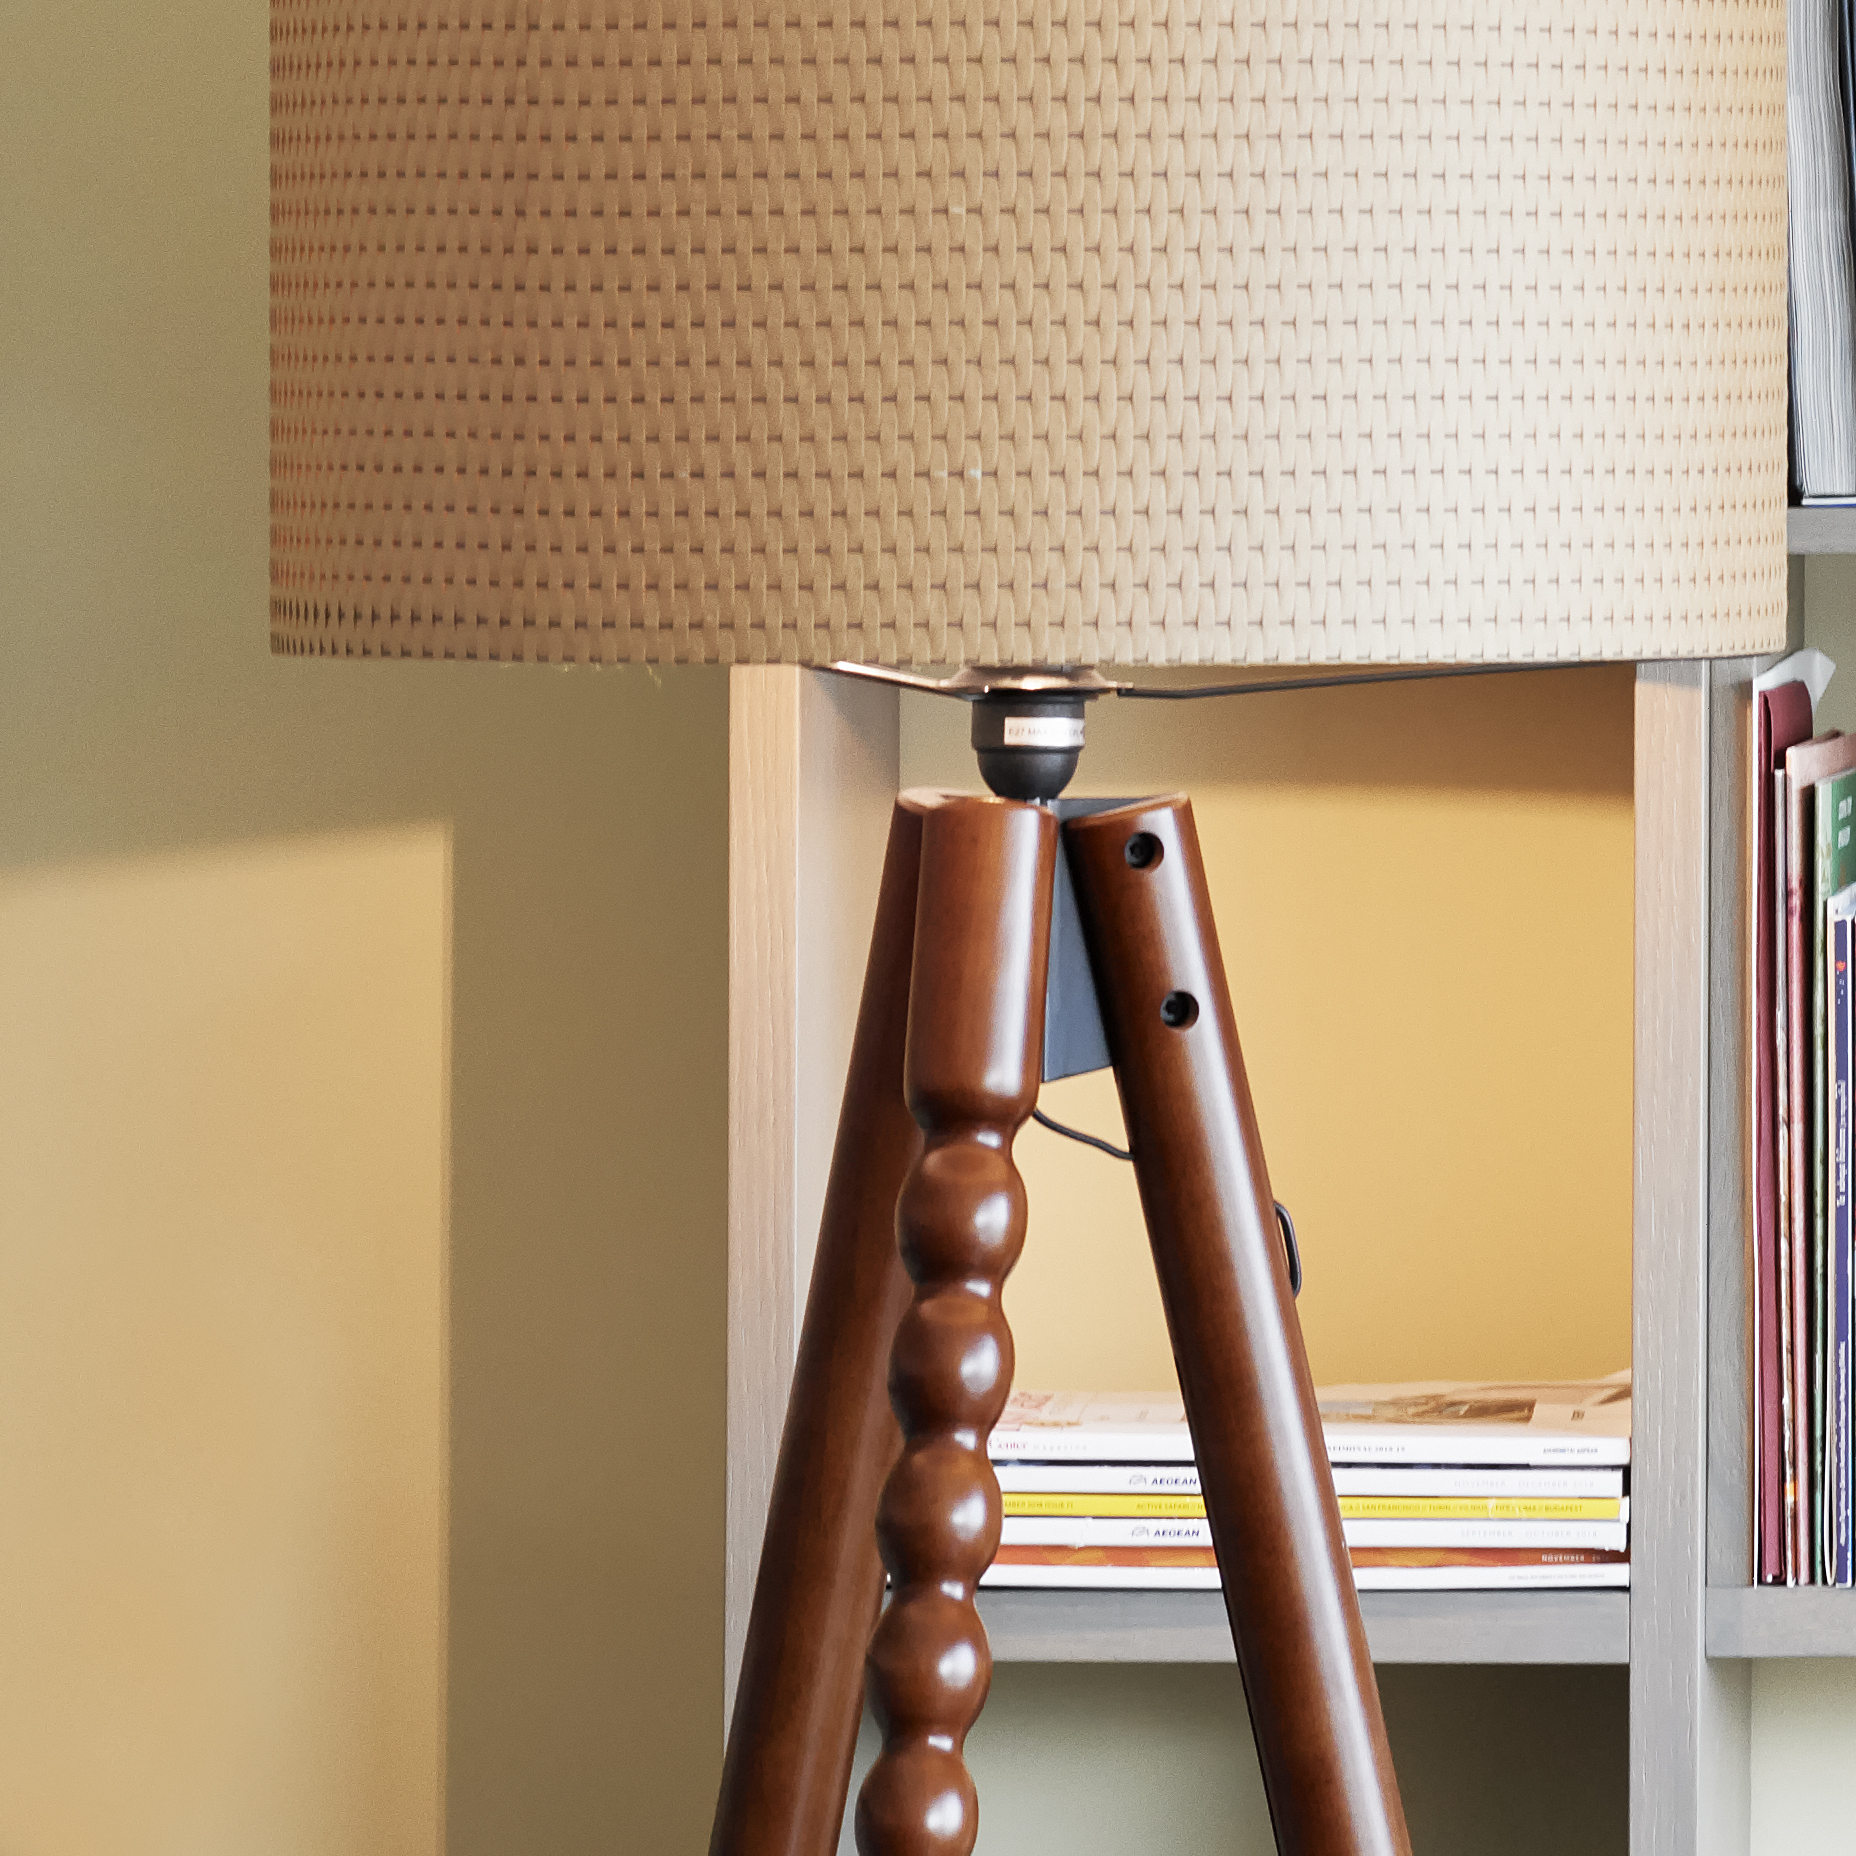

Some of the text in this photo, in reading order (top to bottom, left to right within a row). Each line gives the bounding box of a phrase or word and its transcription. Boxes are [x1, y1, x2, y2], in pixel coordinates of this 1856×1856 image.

[1151, 1477, 1198, 1487] AEGEAN
[1454, 1480, 1507, 1488] NOVEMBER
[1153, 1529, 1201, 1539] AEGEAN
[1459, 1530, 1514, 1538] SEPTEMBER
[1540, 1553, 1586, 1564] NOVEMBER
